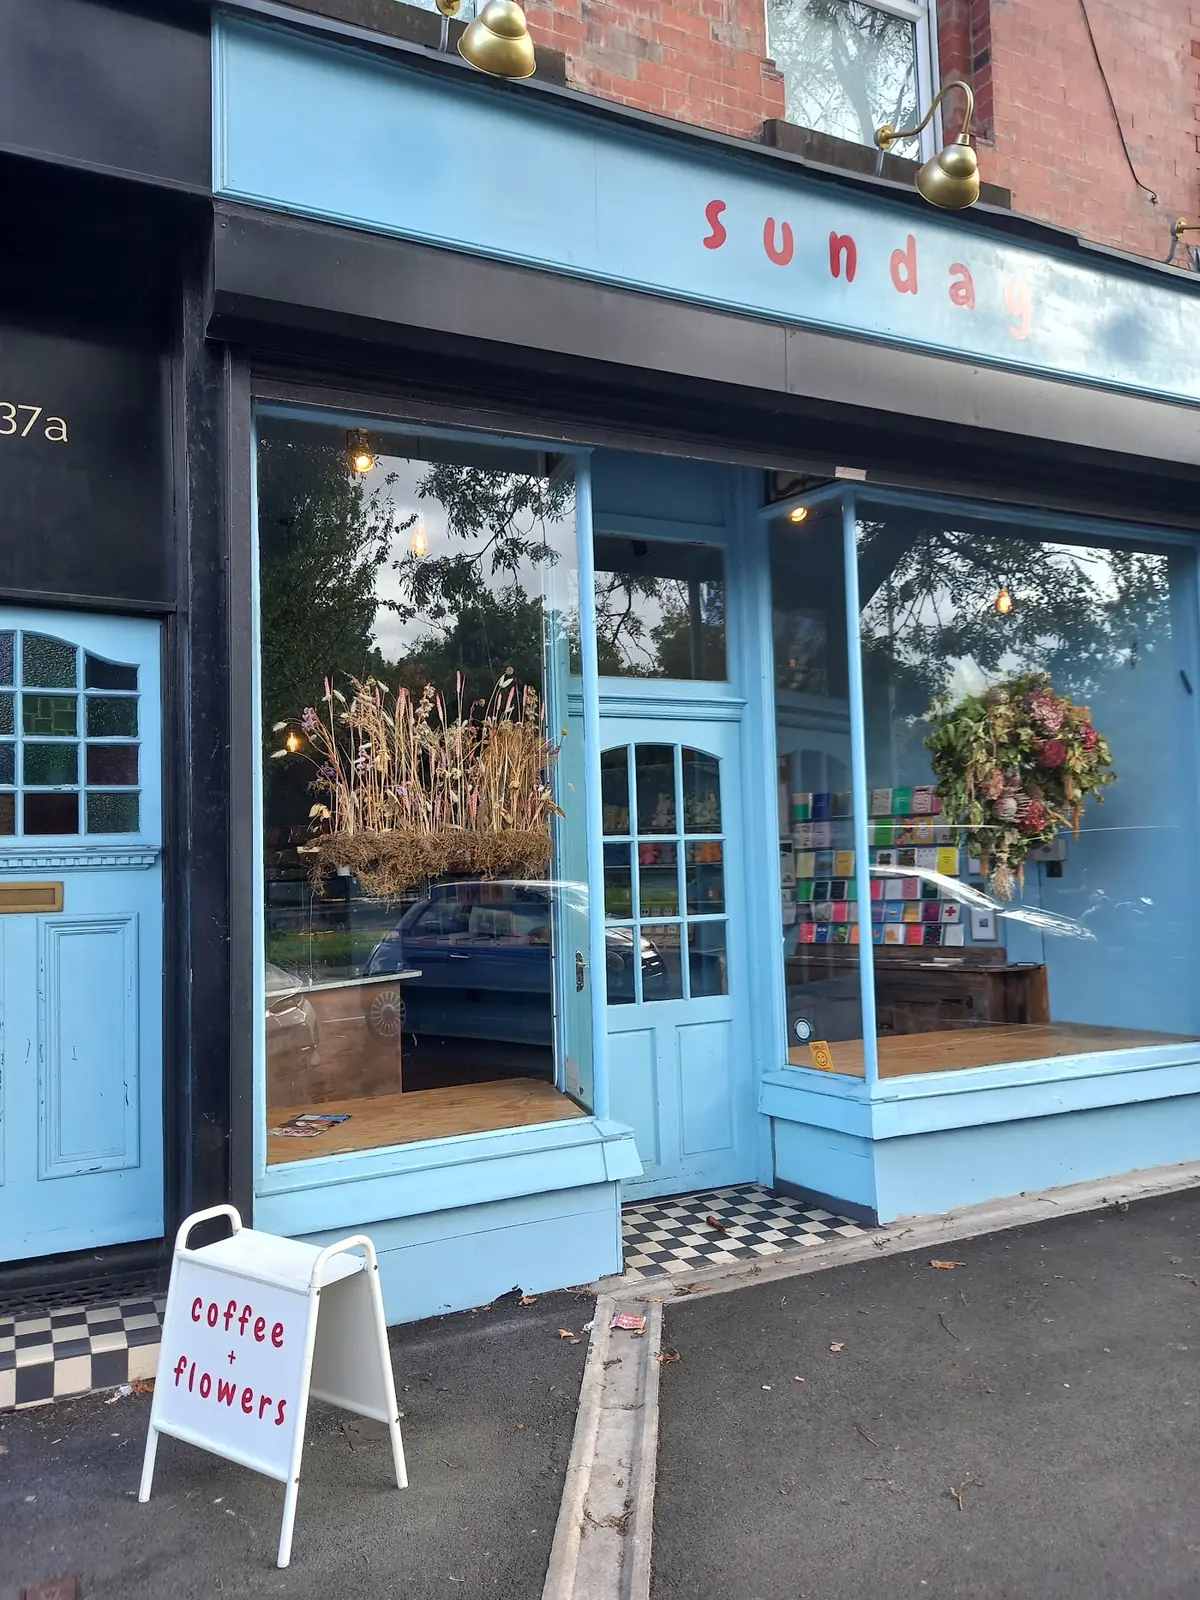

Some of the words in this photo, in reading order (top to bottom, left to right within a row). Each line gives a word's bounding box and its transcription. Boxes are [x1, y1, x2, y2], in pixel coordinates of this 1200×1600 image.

[702, 200, 1033, 340] sunday
[0, 401, 68, 443] 37a
[191, 1297, 285, 1348] coffee
[173, 1355, 287, 1426] flowers
